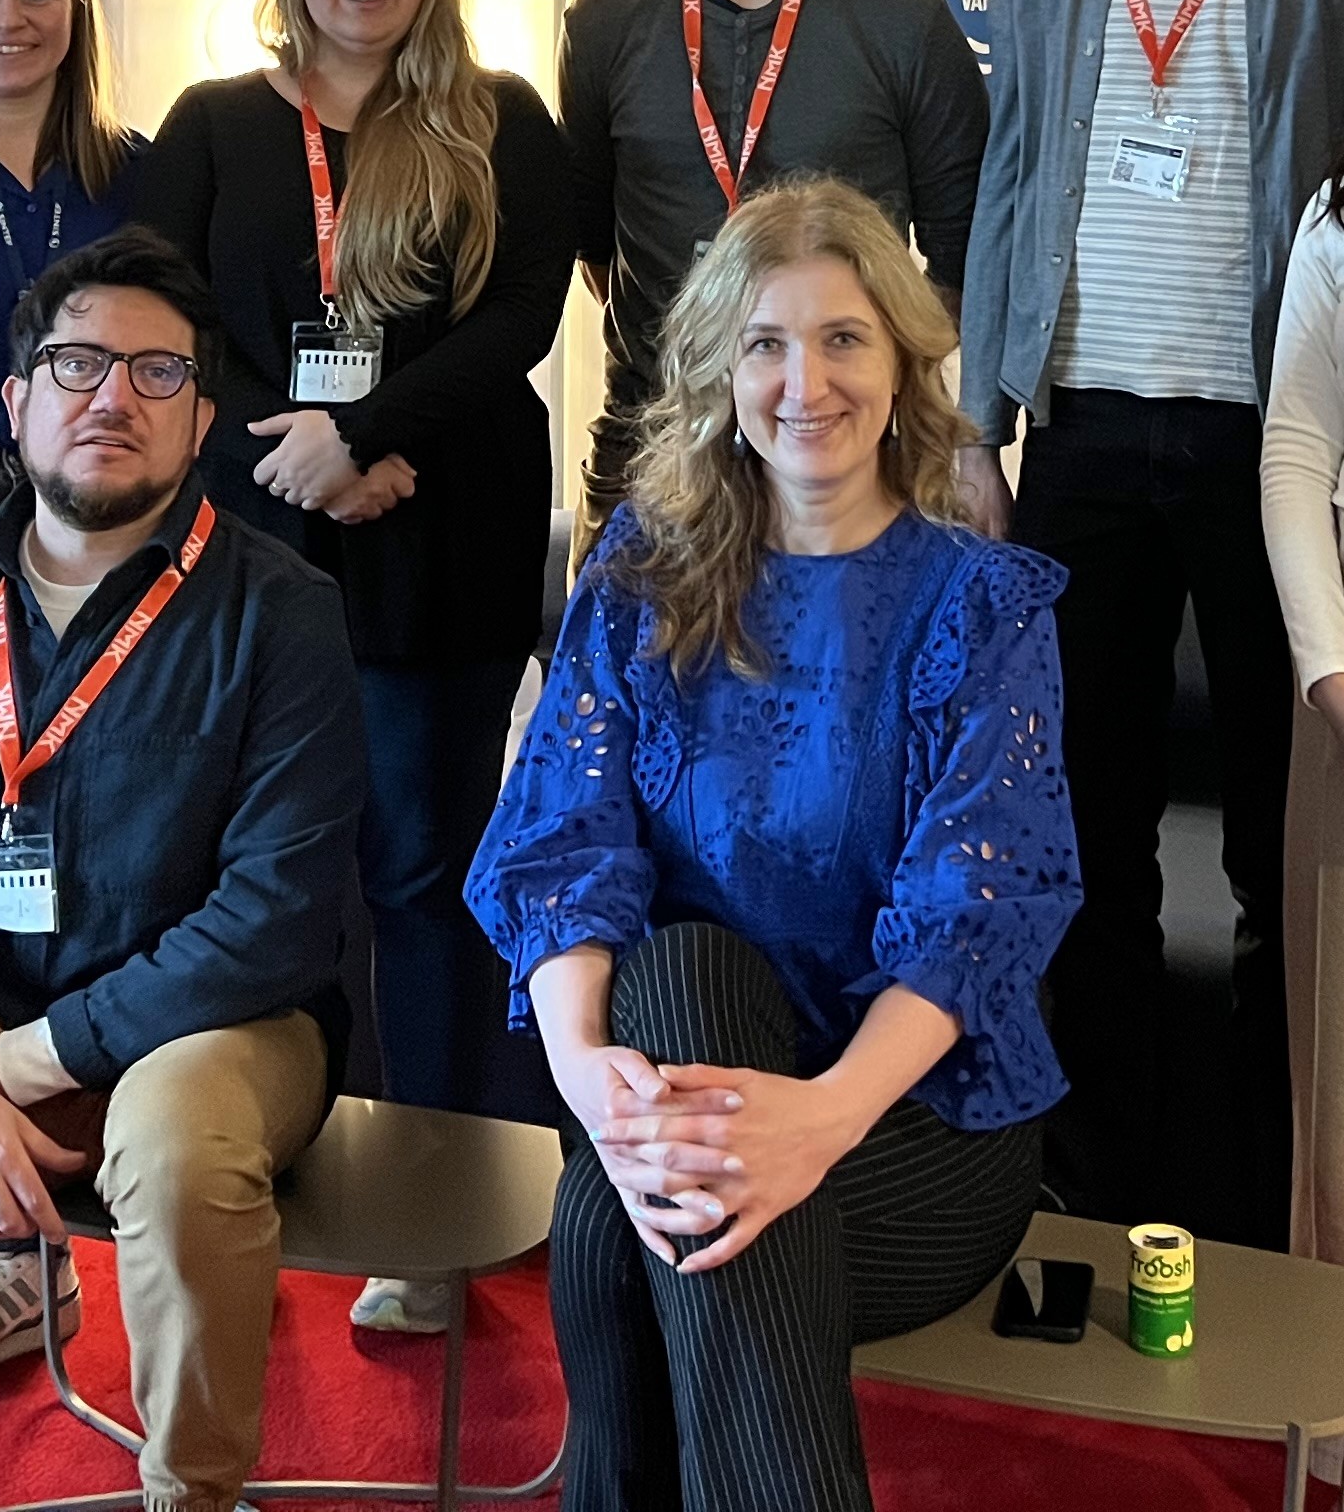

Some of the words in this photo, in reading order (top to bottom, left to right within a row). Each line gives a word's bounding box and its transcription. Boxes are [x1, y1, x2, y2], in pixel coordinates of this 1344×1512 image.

[757, 45, 787, 91] NMK
[307, 131, 325, 166] NMK
[700, 124, 729, 172] NMK
[315, 194, 332, 239] NMK
[104, 610, 152, 665] NMK
[40, 695, 89, 754] NMK
[1131, 1250, 1191, 1278] froosh
